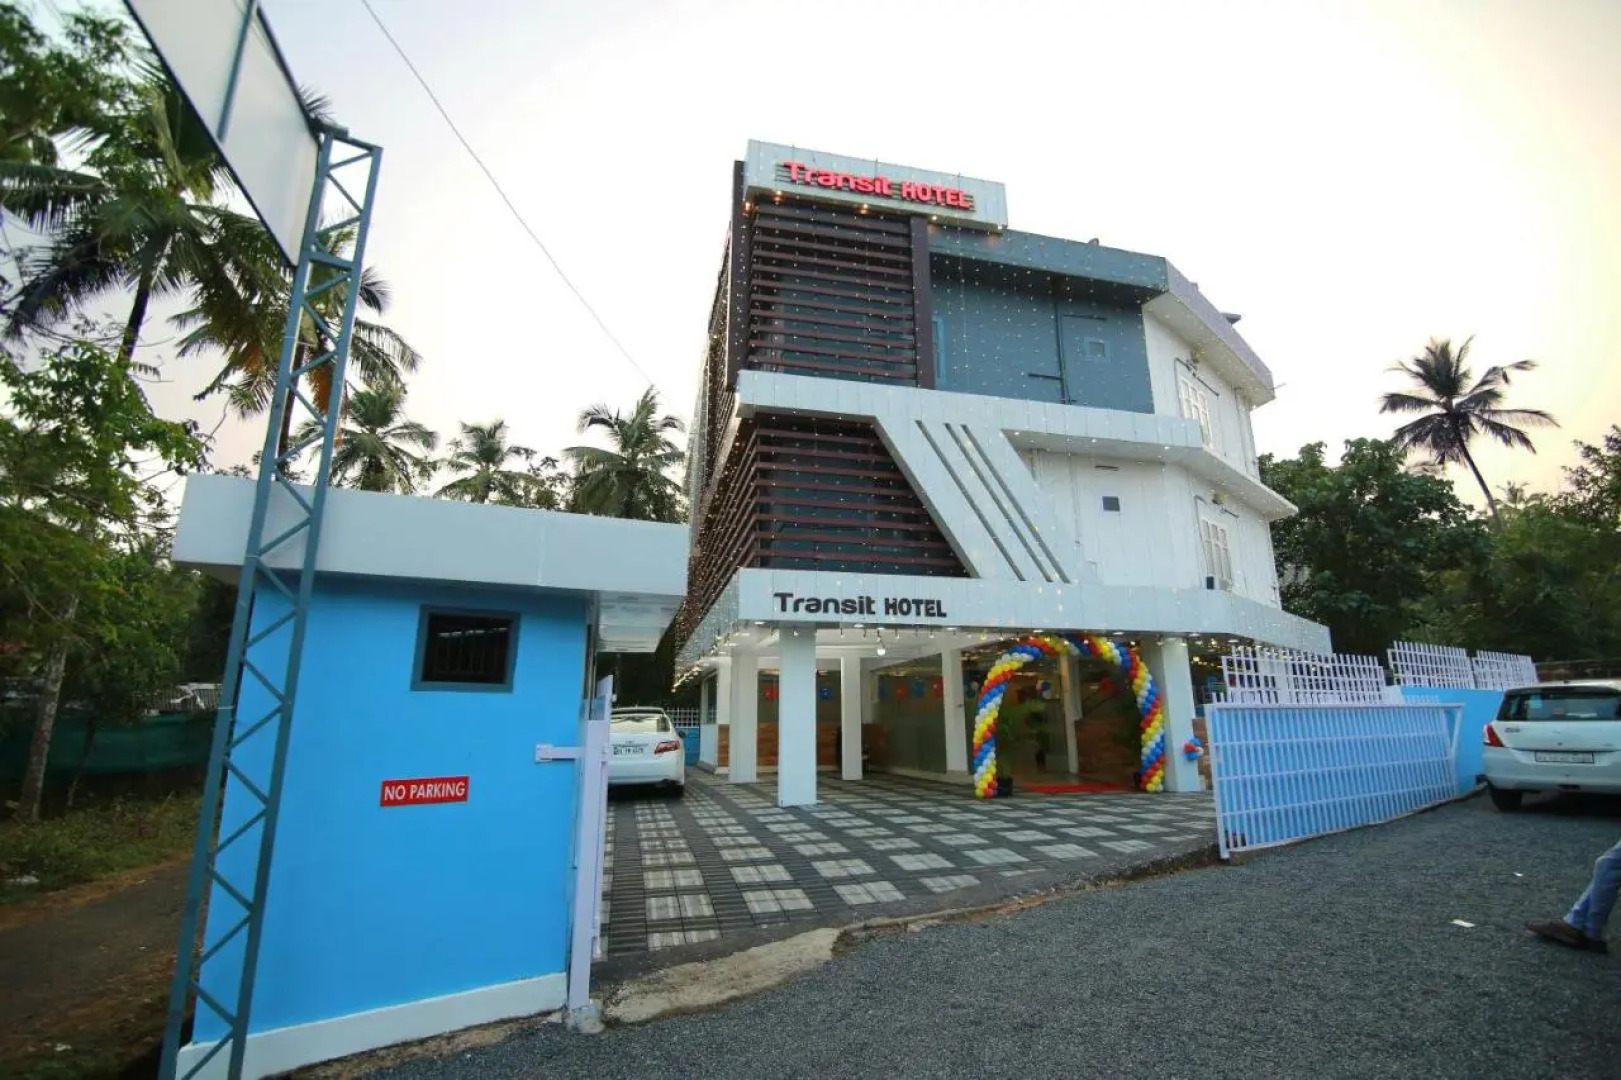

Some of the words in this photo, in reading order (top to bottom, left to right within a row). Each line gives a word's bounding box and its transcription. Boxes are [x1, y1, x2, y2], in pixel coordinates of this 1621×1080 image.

[784, 161, 892, 196] Transit
[900, 181, 974, 209] HOTEL
[774, 592, 876, 615] Transit
[884, 597, 947, 618] HOTEL
[384, 785, 406, 800] NO
[409, 781, 466, 799] PARKING
